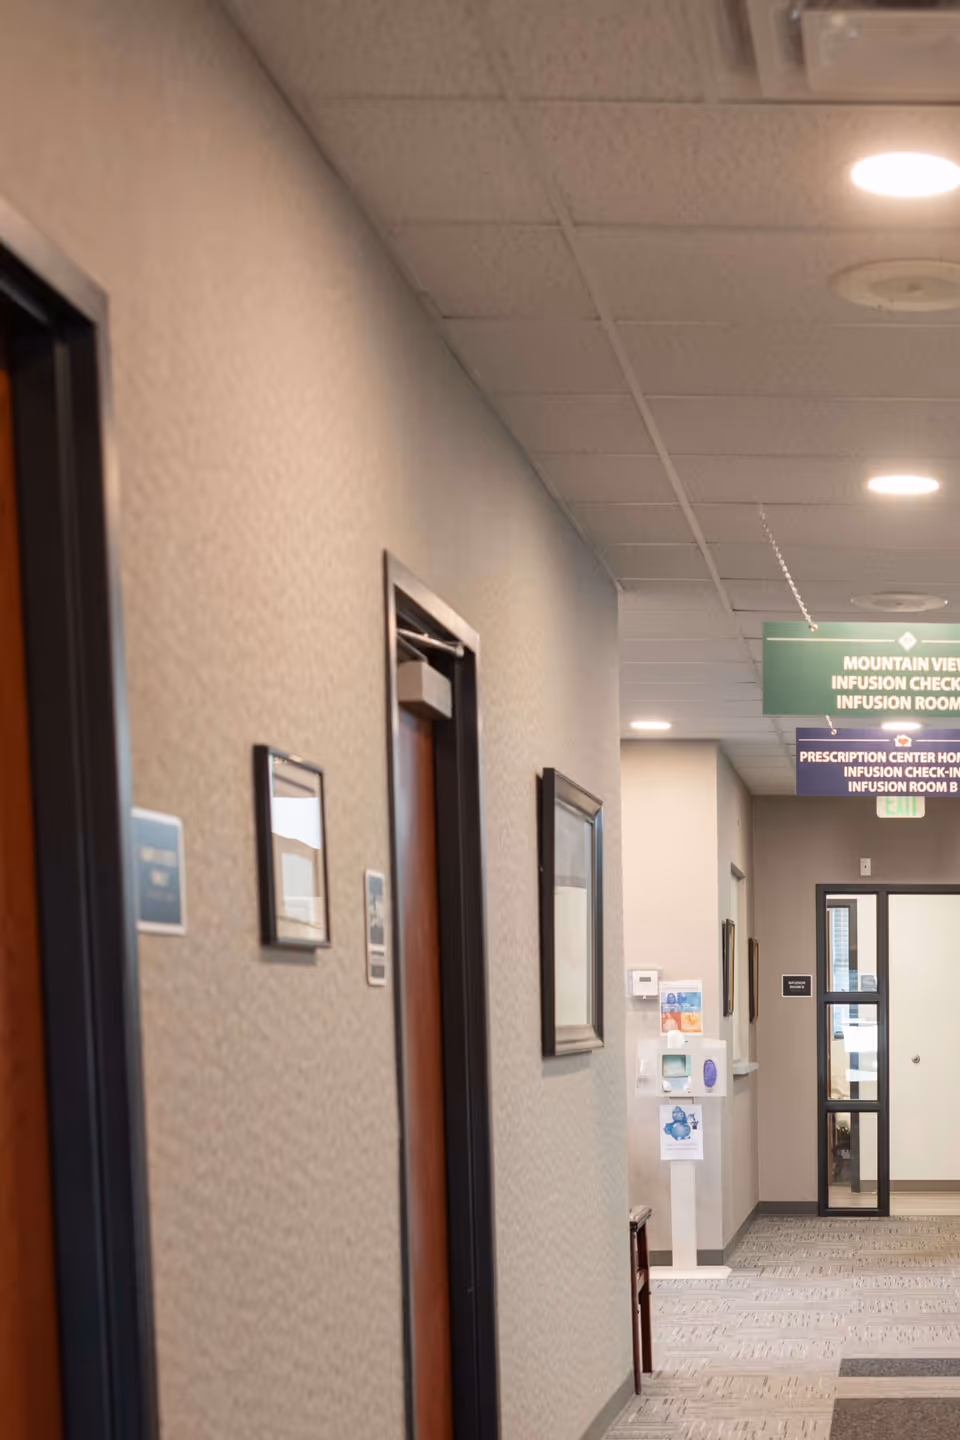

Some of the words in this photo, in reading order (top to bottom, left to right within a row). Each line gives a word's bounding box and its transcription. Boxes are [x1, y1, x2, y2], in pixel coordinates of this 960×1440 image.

[843, 656, 929, 671] MOUNTAIN
[831, 675, 907, 690] INFUSION
[836, 694, 912, 710] INFUSION
[799, 751, 886, 763] PRESCRIPTION
[888, 751, 936, 763] CENTER
[843, 766, 902, 778] INFUSION
[848, 781, 906, 792] INFUSION
[909, 781, 947, 793] ROOM
[949, 781, 958, 793] B
